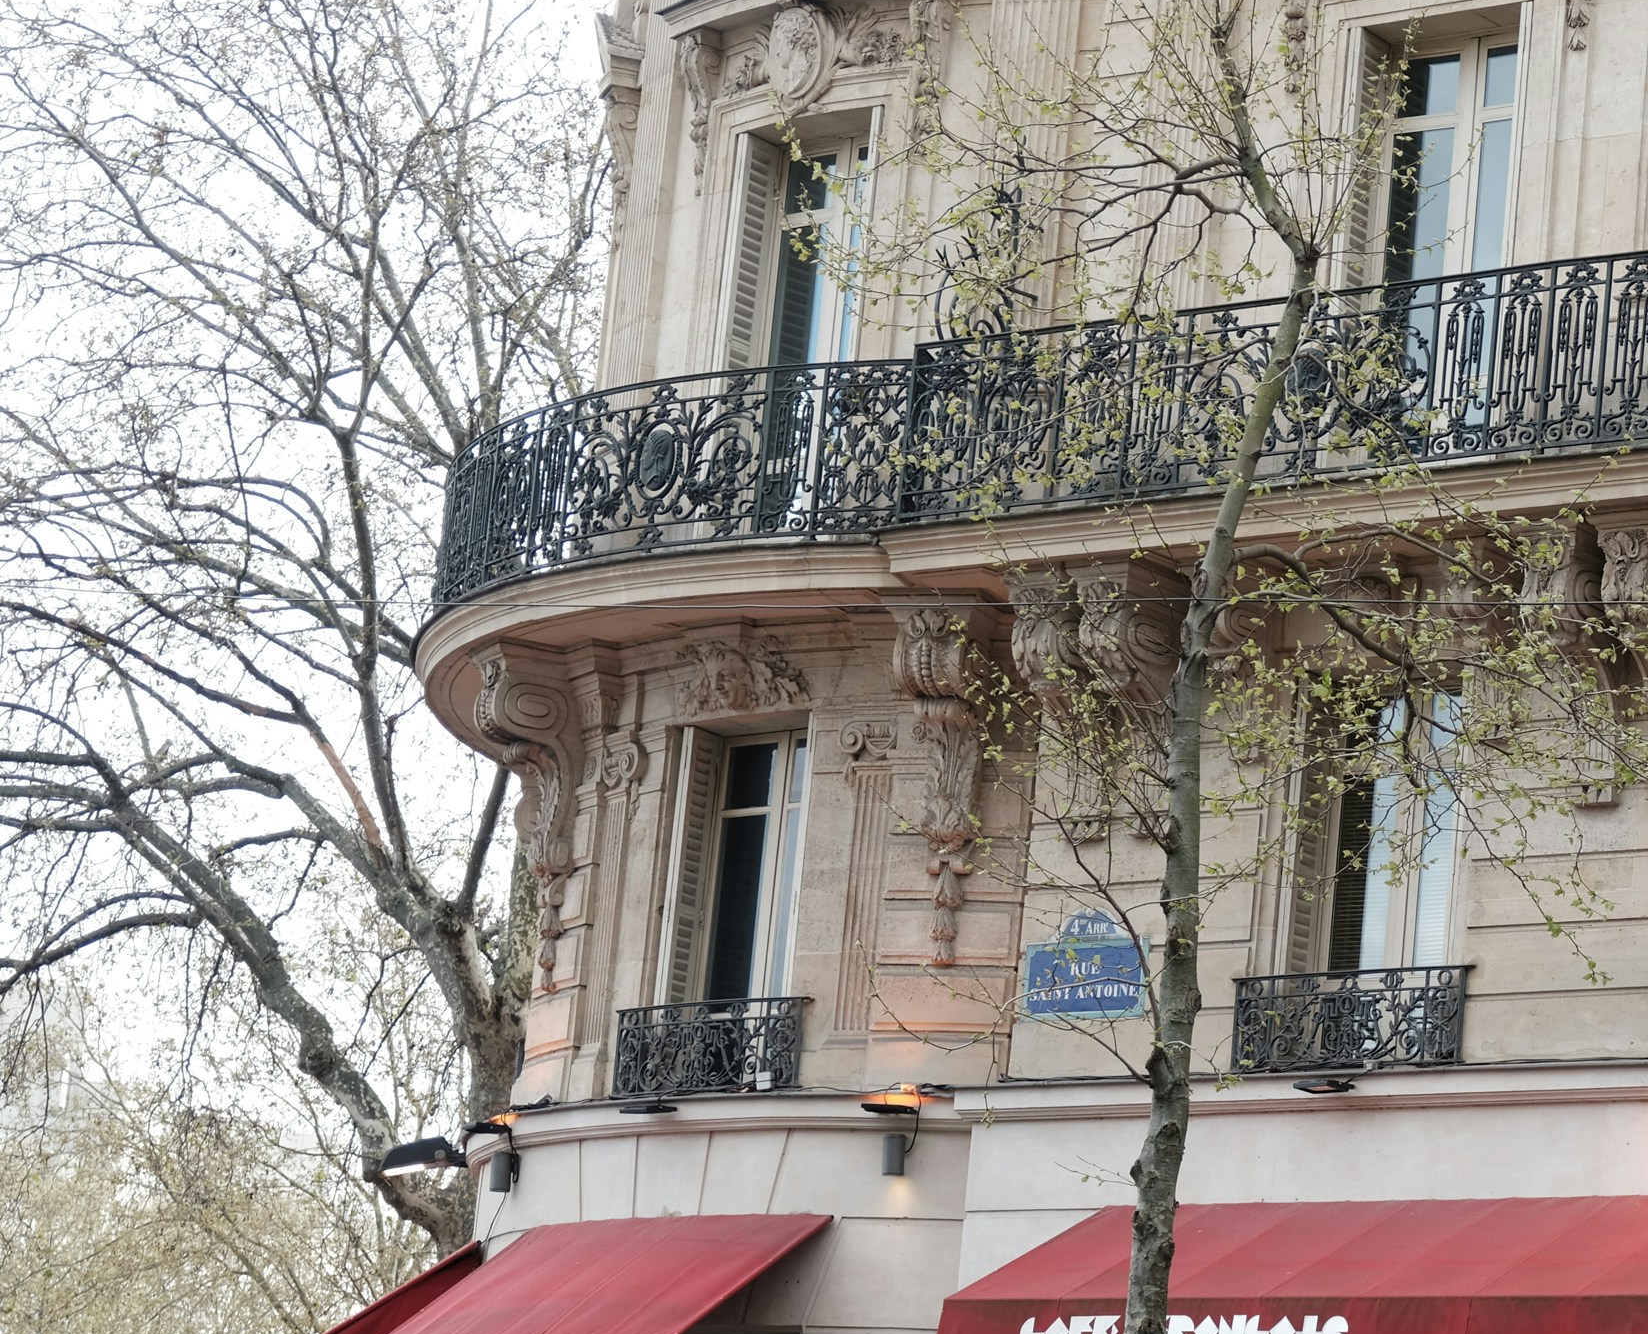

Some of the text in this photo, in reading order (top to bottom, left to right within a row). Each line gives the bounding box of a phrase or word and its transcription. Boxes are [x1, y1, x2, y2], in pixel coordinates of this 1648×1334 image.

[1070, 960, 1101, 976] RUE
[1029, 984, 1139, 1002] SAINT ANTOINE
